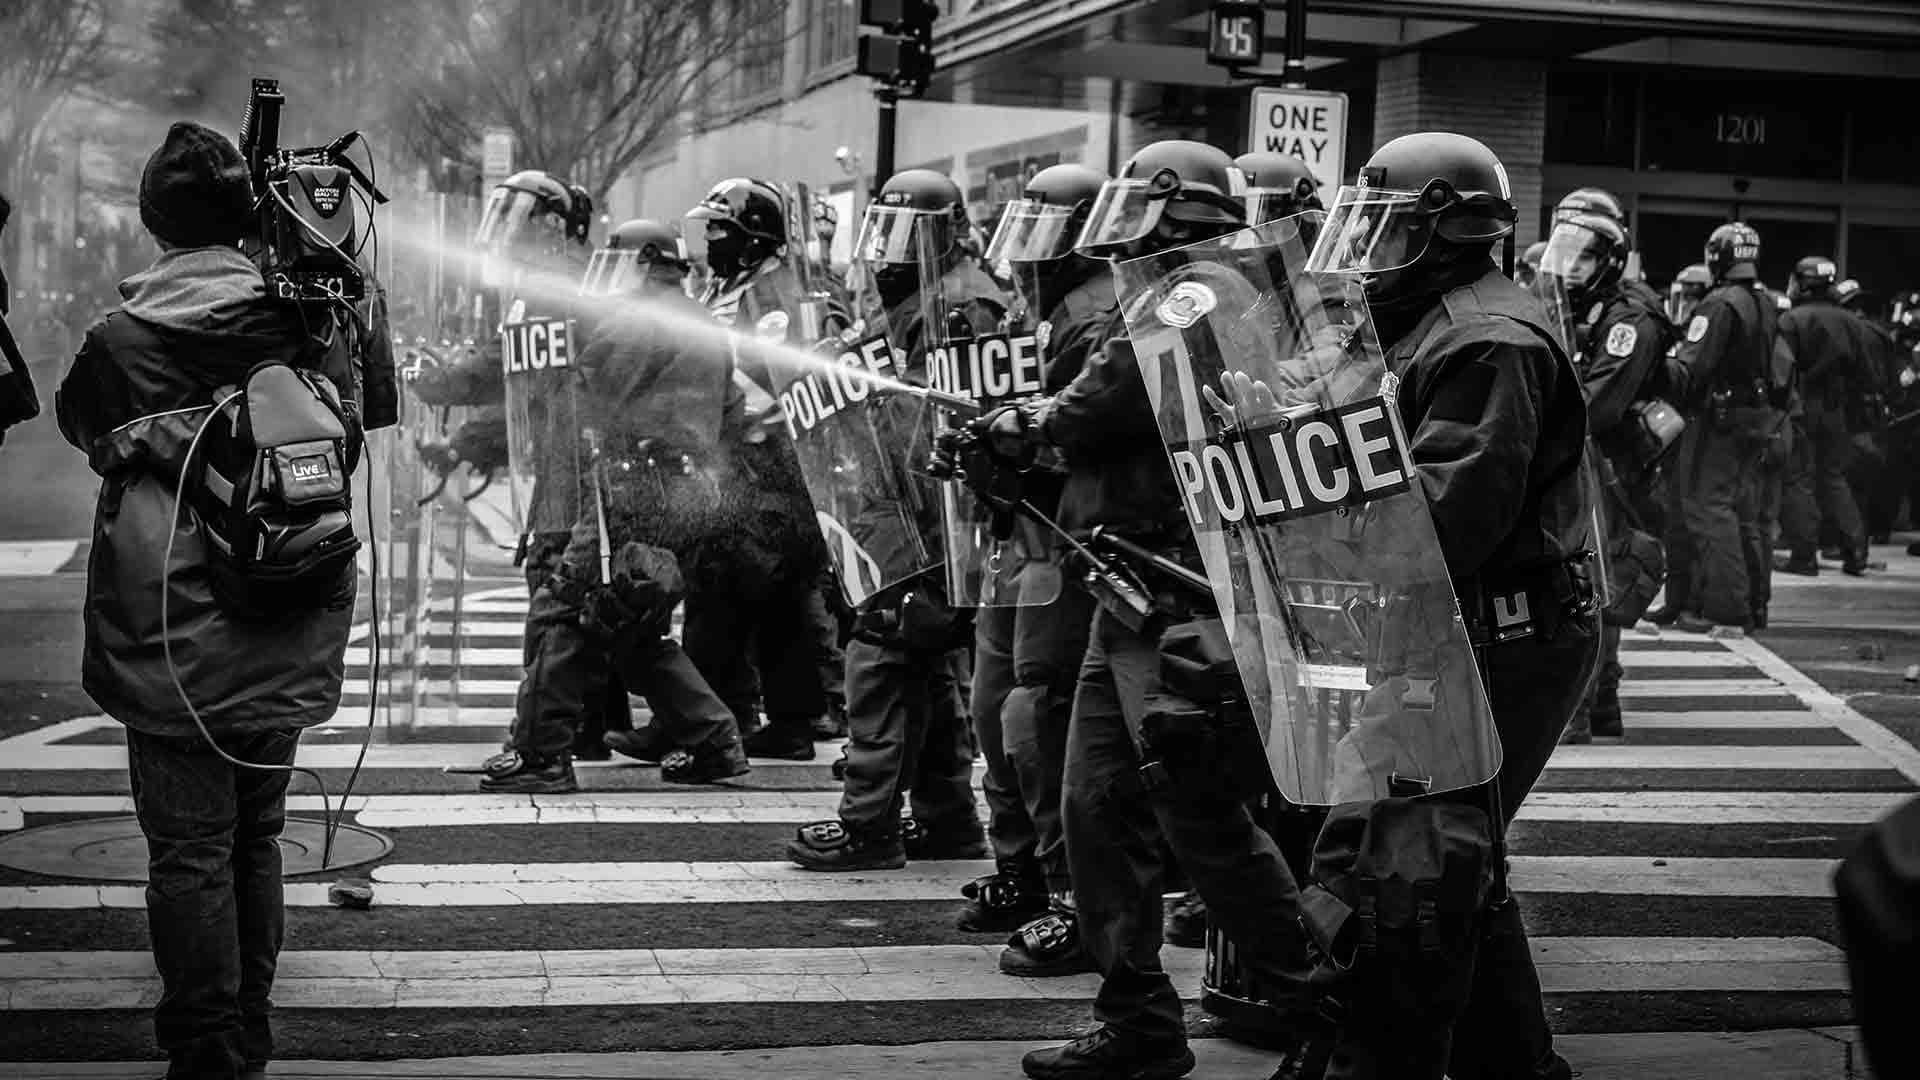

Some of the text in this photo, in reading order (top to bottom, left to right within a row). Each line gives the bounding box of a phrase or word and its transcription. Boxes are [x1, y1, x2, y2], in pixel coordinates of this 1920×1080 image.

[1221, 17, 1252, 57] 45
[1269, 104, 1329, 132] ONE
[1715, 114, 1766, 144] 1201
[1266, 135, 1329, 163] WAY
[926, 335, 1041, 401] POLICE
[780, 337, 898, 441] POLICE
[1173, 405, 1403, 525] POLICE
